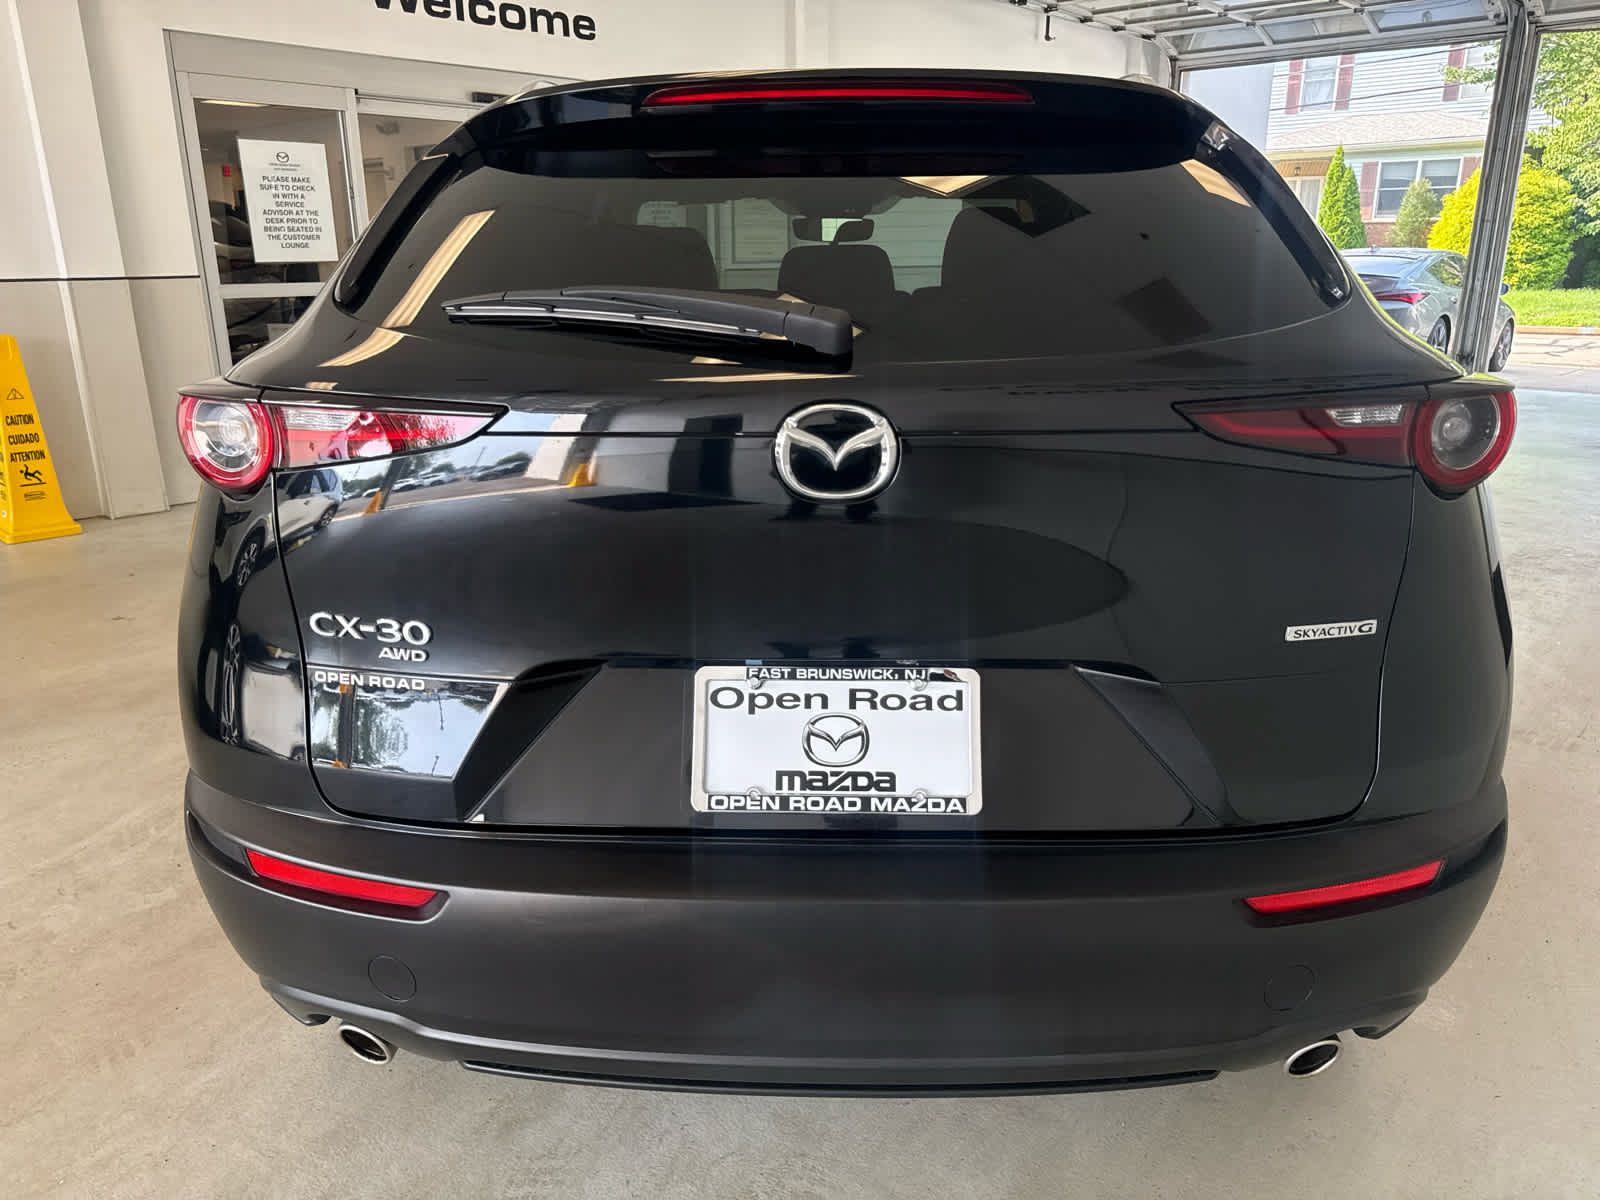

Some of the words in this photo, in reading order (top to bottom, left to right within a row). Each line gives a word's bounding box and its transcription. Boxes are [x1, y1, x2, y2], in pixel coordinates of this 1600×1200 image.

[291, 176, 311, 184] MAKE
[291, 184, 316, 192] CHECK
[309, 217, 318, 225] TO
[282, 233, 321, 241] CUSTOMER
[5, 414, 34, 426] CAUTION
[8, 432, 40, 445] CUIDADO
[10, 449, 46, 462] ATTENTION
[309, 611, 432, 646] CX-30
[378, 647, 429, 662] AWD
[314, 670, 364, 687] OPEN
[368, 675, 426, 690] ROAD
[796, 667, 899, 680] BRUNSWICK,
[709, 686, 829, 715] Open
[848, 688, 964, 712] Road
[710, 795, 780, 811] OPEN
[789, 796, 862, 812] ROAD
[870, 797, 966, 814] MAZDA
